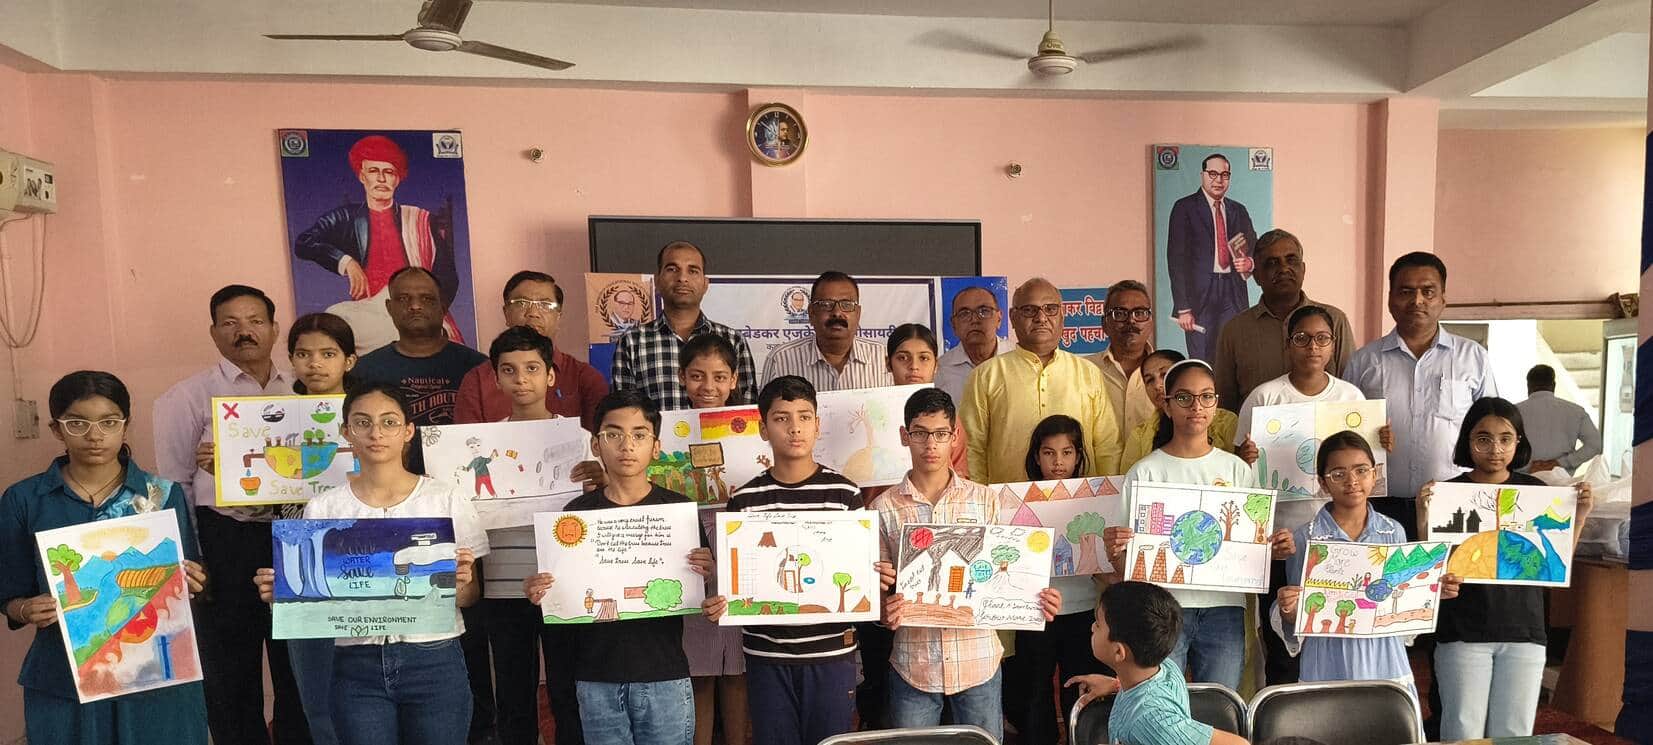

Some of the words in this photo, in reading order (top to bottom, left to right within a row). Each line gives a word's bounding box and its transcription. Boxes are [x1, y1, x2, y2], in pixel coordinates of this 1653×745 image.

[1079, 327, 1105, 342] पहचा
[408, 376, 443, 385] Nautical
[228, 423, 271, 439] Save
[269, 481, 304, 495] Save
[343, 555, 372, 565] WATER
[349, 581, 372, 590] LIFE
[363, 615, 417, 624] ENVIRONMENT
